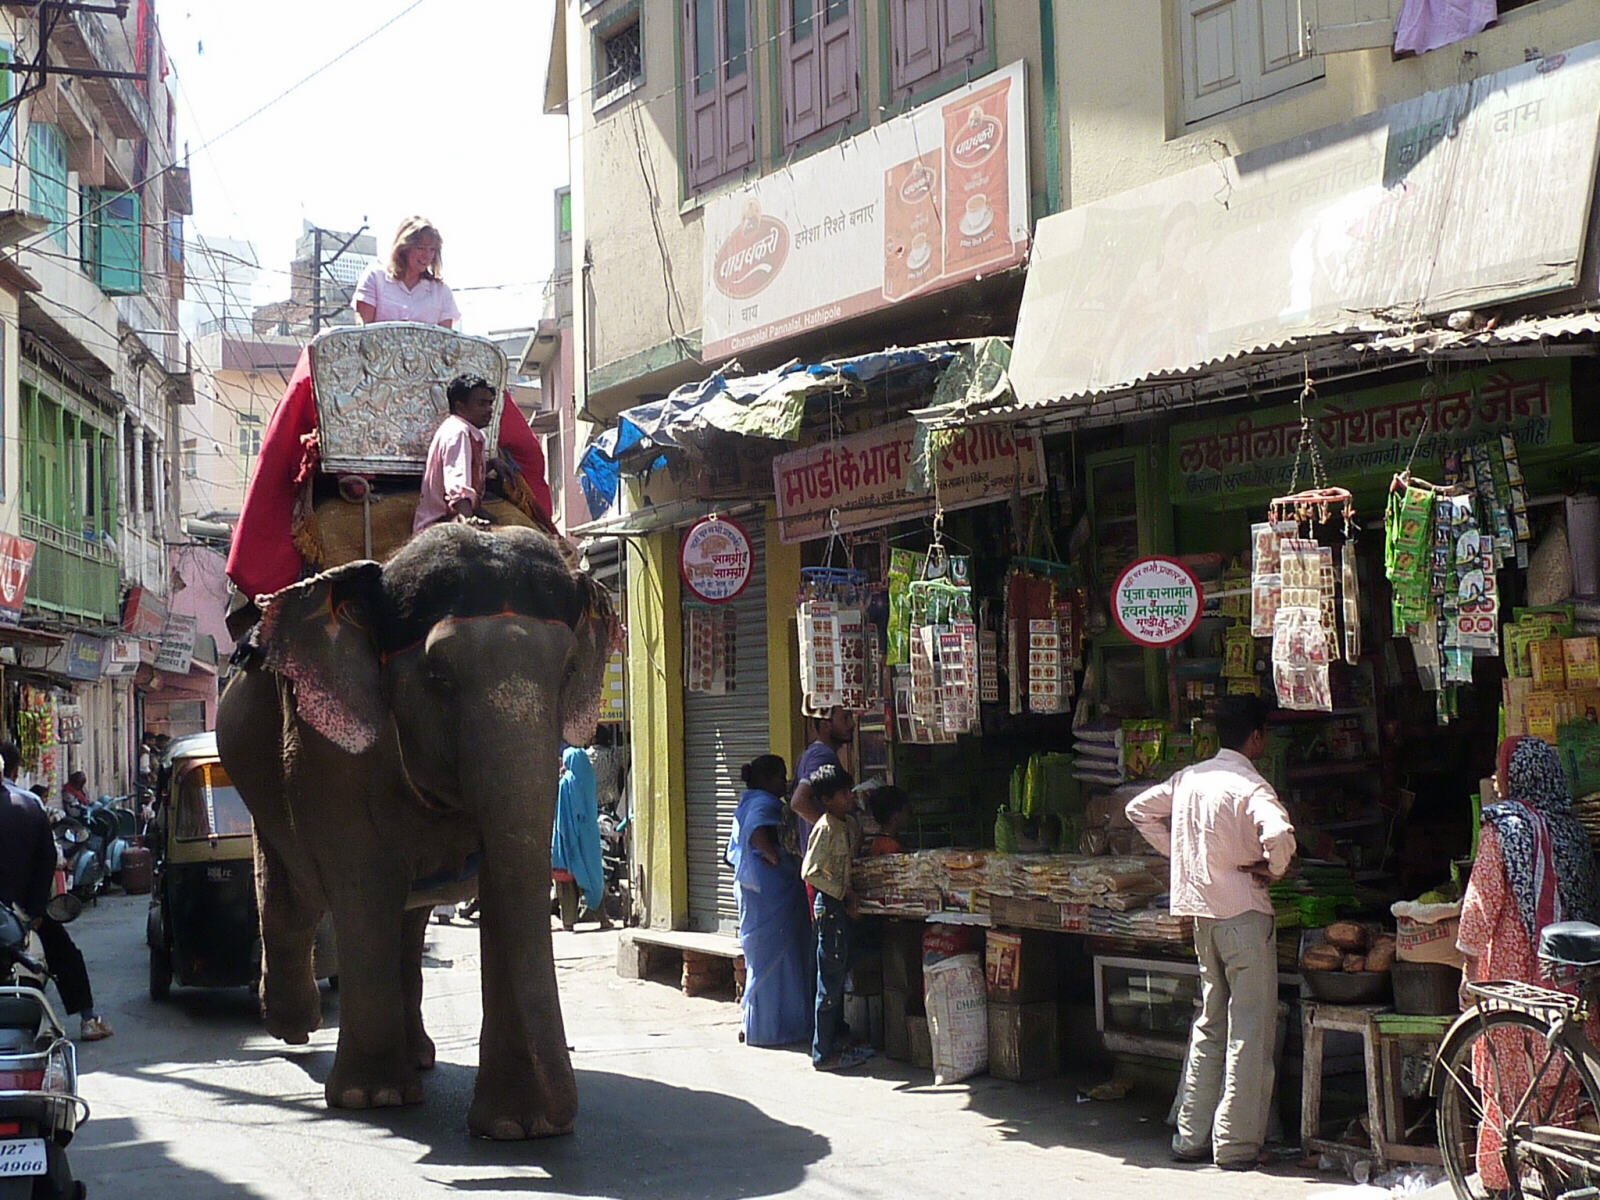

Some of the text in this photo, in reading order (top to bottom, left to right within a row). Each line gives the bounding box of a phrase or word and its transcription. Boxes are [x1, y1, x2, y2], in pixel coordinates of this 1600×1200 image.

[794, 224, 821, 249] हमेशा
[823, 209, 847, 238] रिश्ते
[740, 304, 759, 322] चाय
[804, 306, 841, 327] Hathipole
[1477, 373, 1550, 422] जैन
[1121, 586, 1193, 605] पूजा का सामान
[1121, 605, 1147, 620] हवन
[1147, 600, 1189, 619] सामग्री
[0, 1160, 43, 1172] 4966
